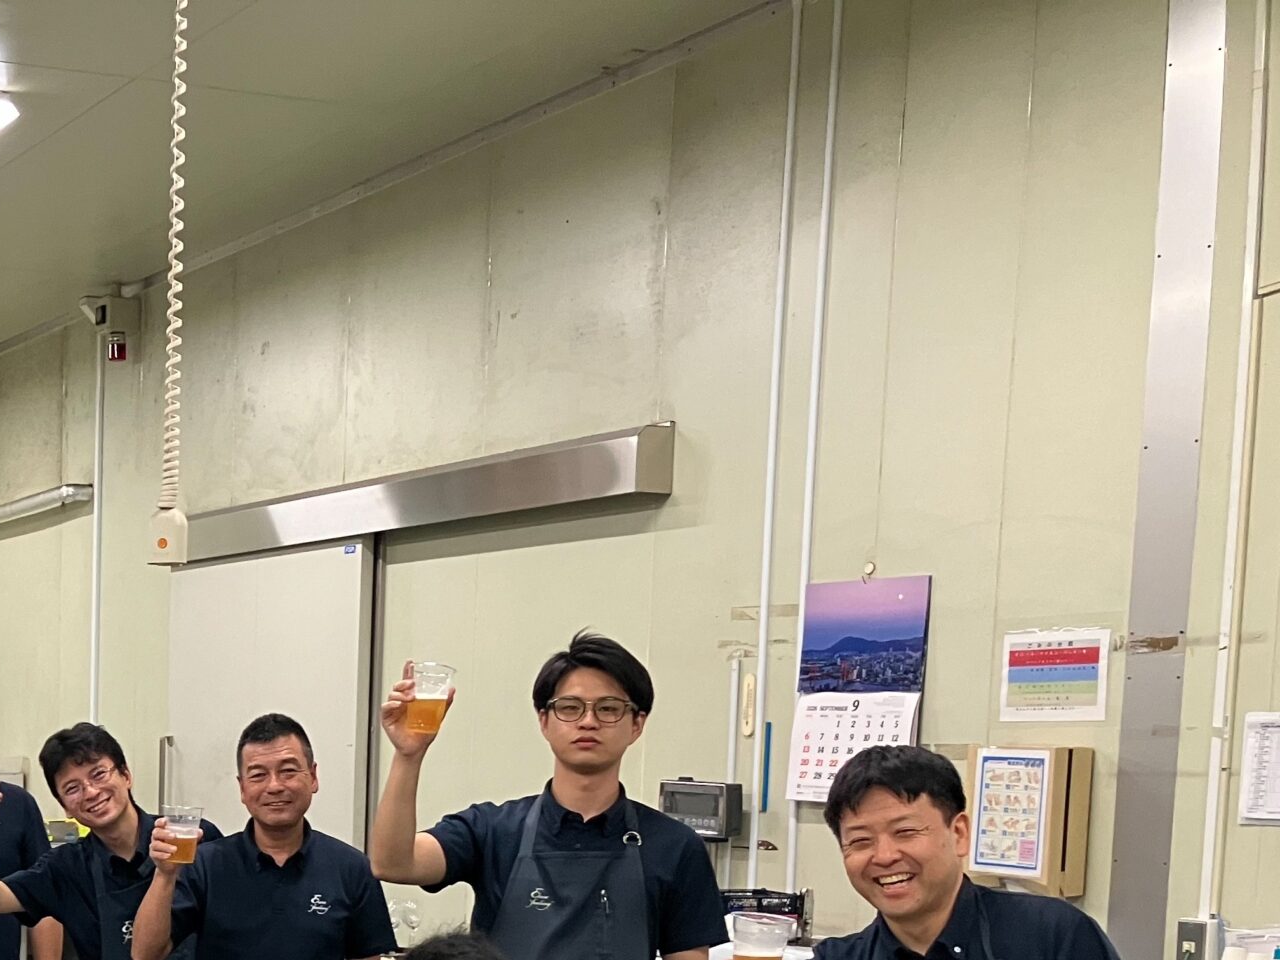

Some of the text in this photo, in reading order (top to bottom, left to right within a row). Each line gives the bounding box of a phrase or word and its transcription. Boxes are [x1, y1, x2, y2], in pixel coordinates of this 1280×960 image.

[851, 699, 860, 712] 9
[850, 720, 856, 728] 2
[819, 732, 825, 740] 7
[891, 734, 899, 742] 12
[802, 745, 810, 753] 13
[831, 746, 839, 754] 15
[846, 747, 854, 755] 16
[815, 759, 823, 767] 21
[828, 759, 838, 767] 22
[813, 772, 822, 780] 28
